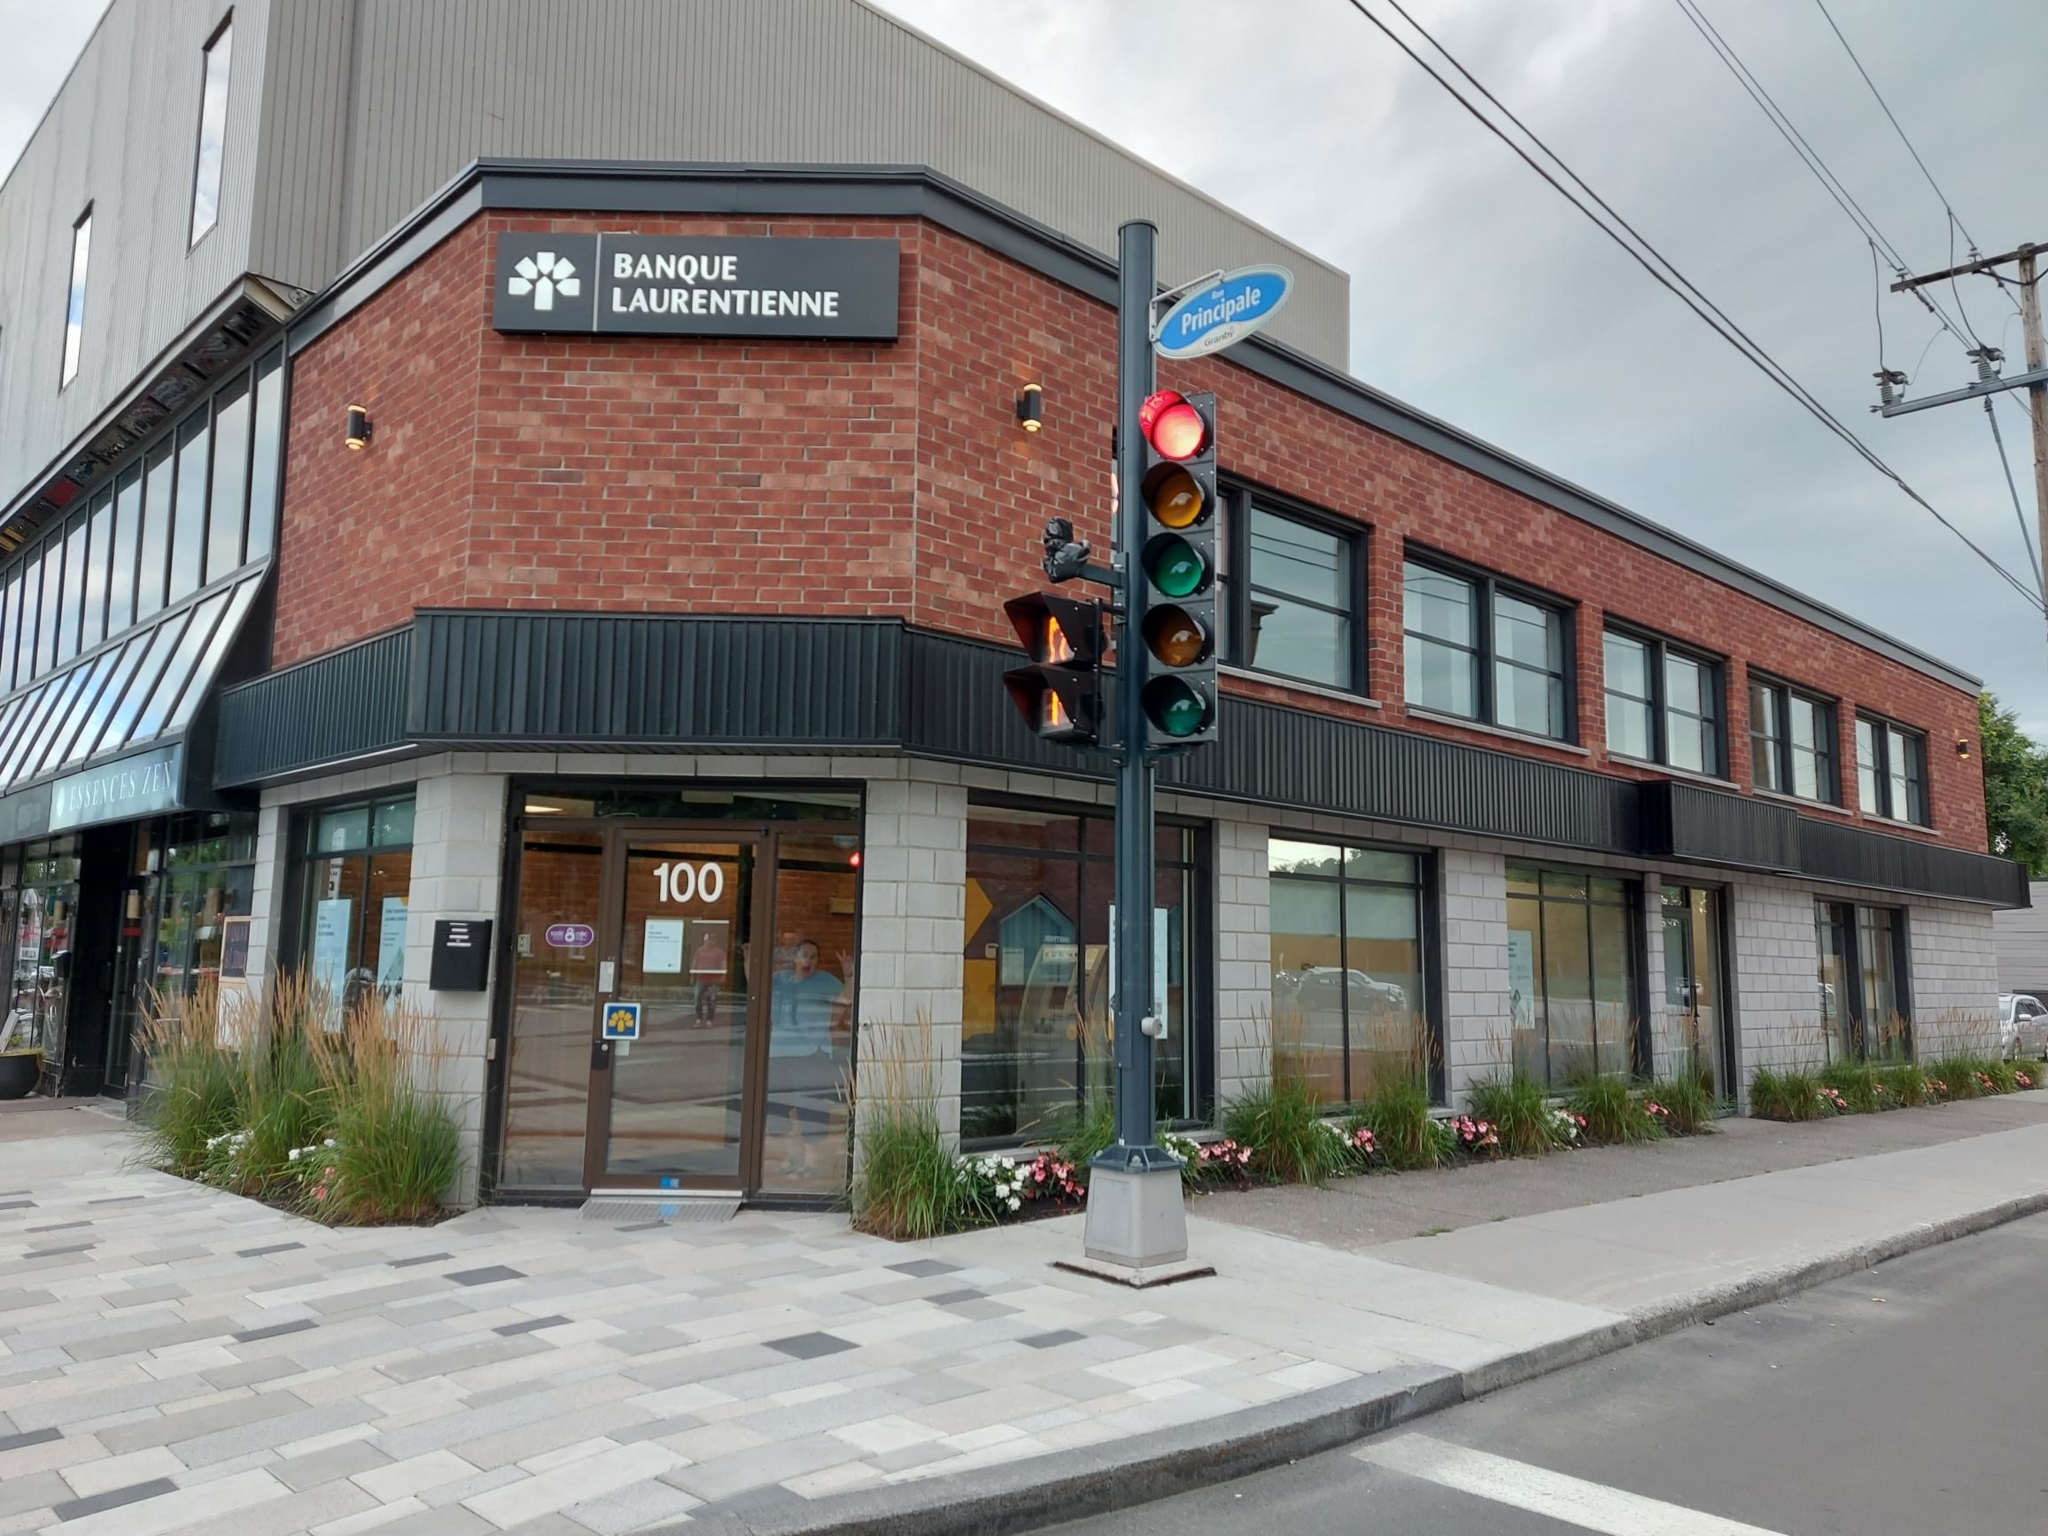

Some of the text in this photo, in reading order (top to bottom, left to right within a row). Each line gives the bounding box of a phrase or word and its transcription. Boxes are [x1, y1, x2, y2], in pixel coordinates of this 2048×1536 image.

[613, 252, 738, 284] BANQUE
[611, 287, 840, 318] LAURENTIENNE
[1182, 286, 1261, 335] Principale
[1205, 331, 1234, 346] Granby
[69, 760, 174, 810] ESSENCES ZEN
[652, 861, 724, 903] 100
